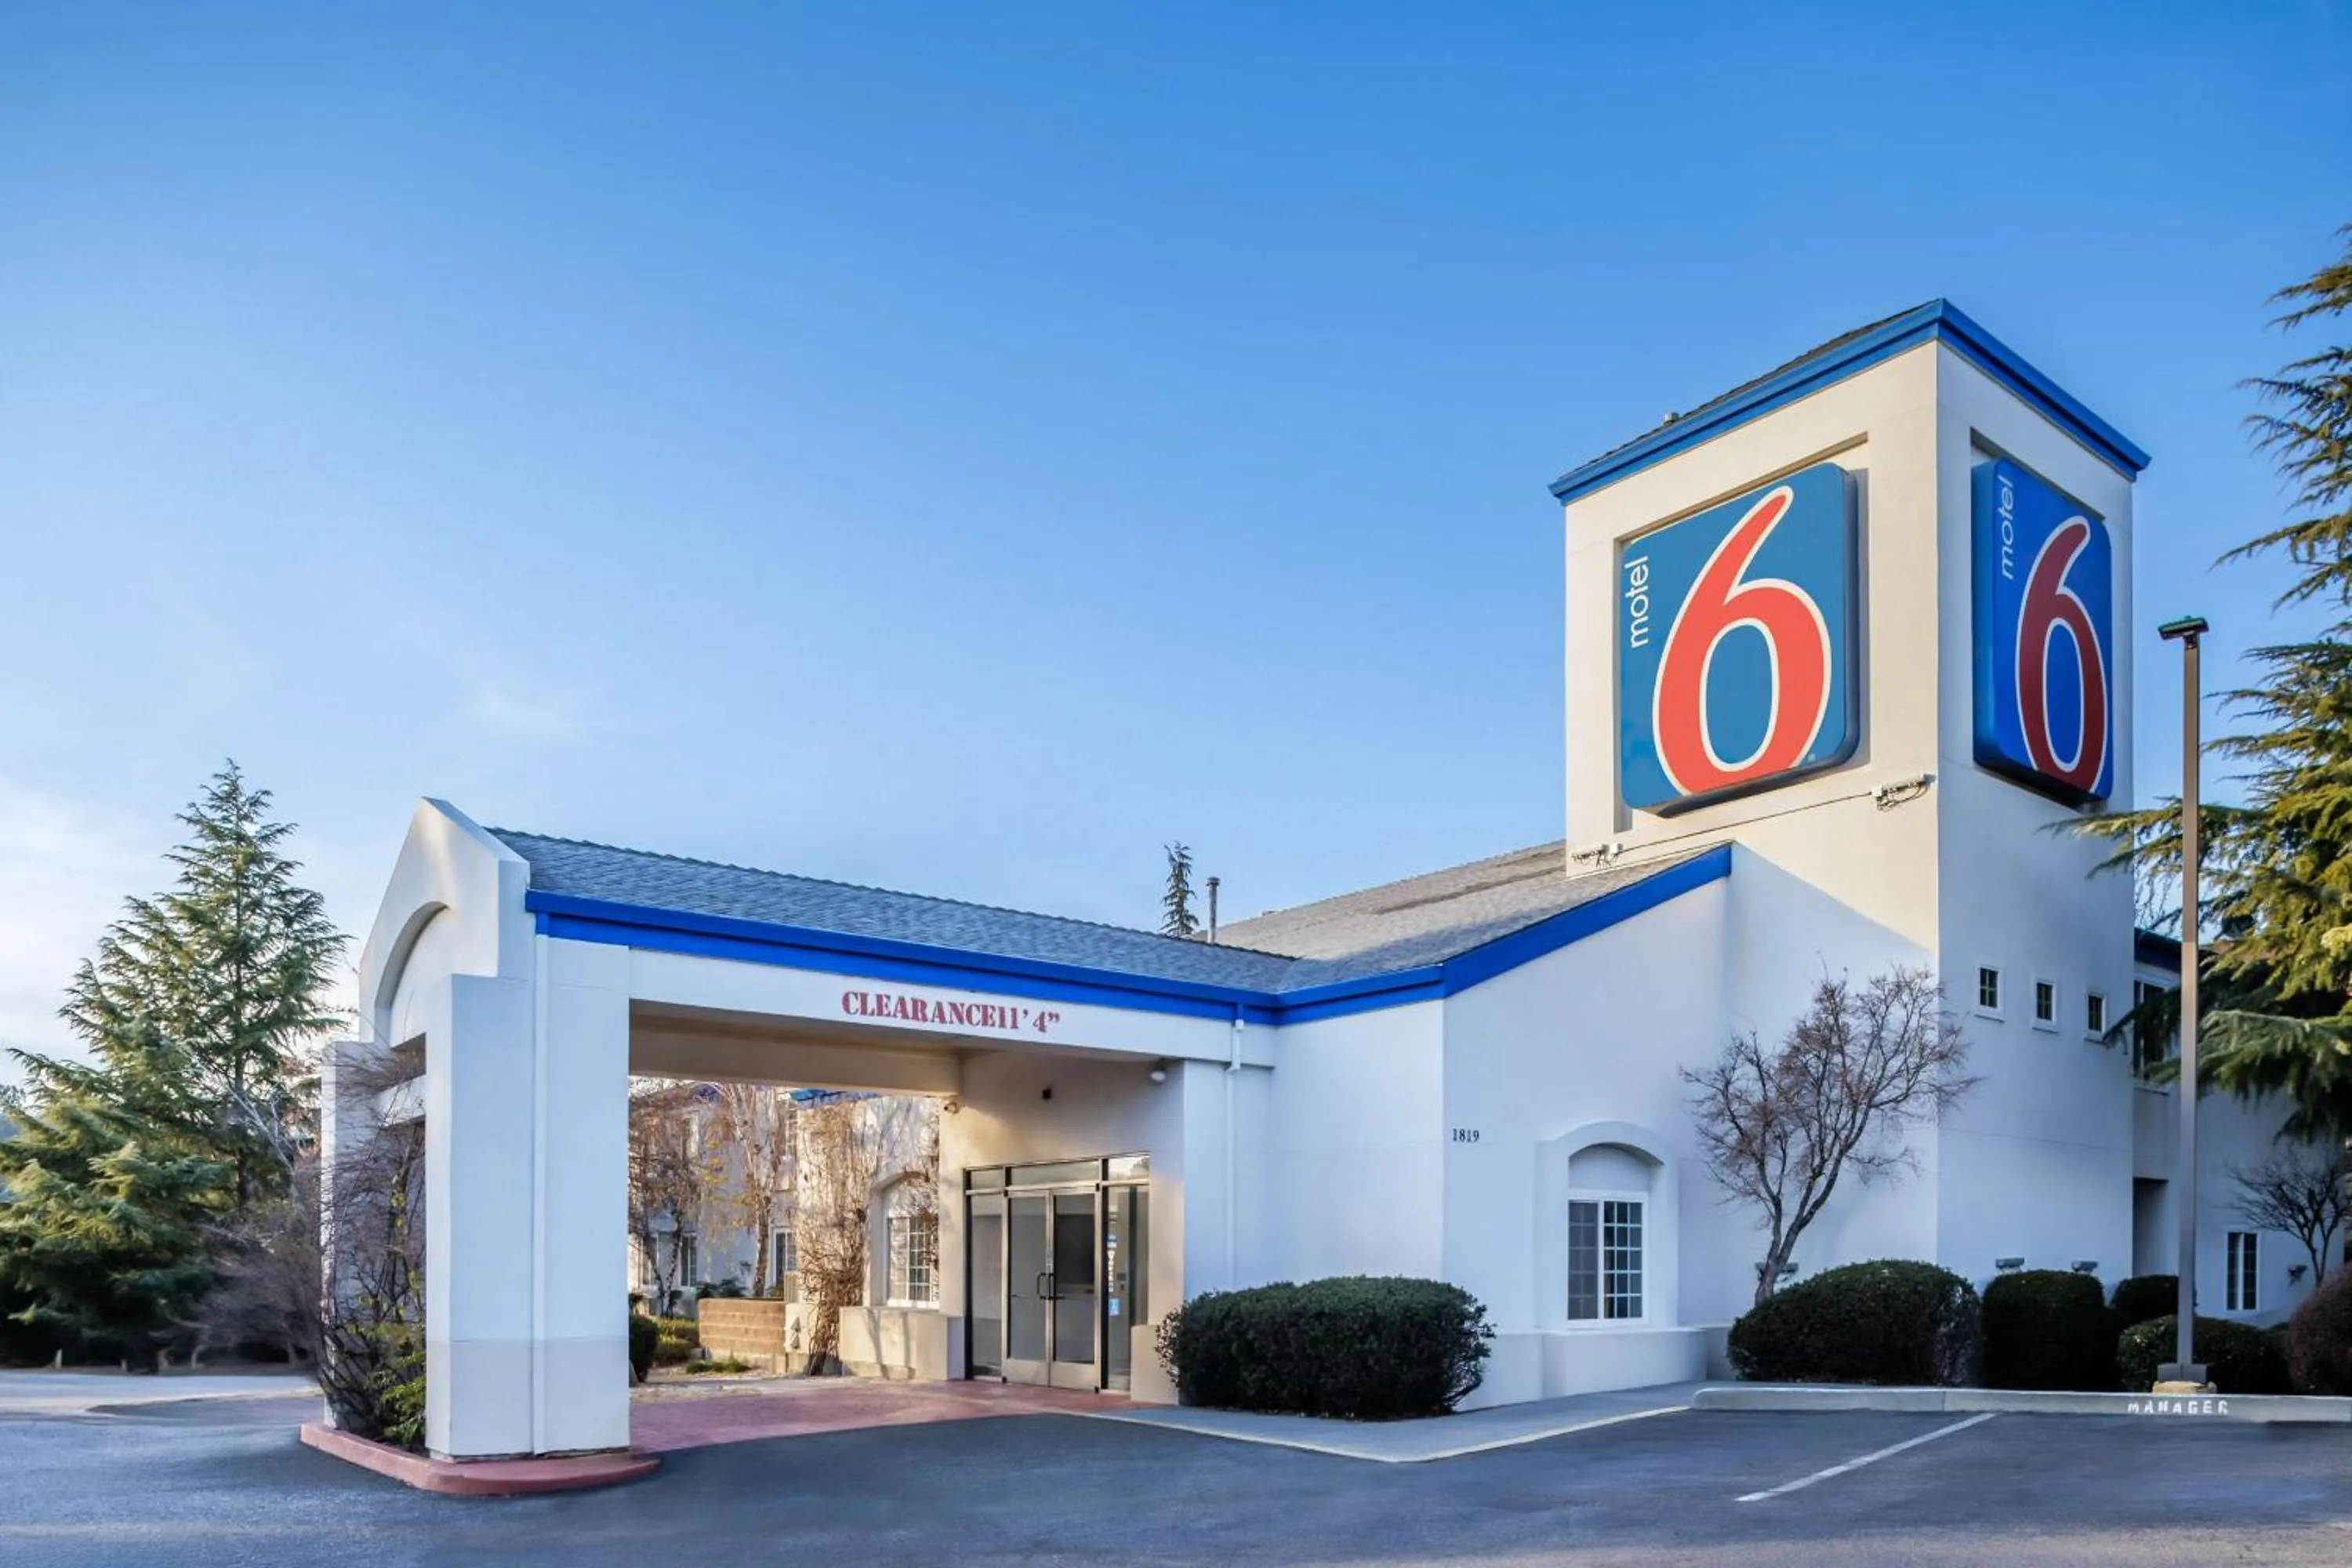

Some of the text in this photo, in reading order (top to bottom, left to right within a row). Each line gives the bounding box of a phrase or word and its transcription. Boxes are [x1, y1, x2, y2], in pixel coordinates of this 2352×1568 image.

[1625, 485, 1832, 796] motel 6
[1998, 474, 2107, 793] motel 6
[1453, 1129, 1479, 1142] 1819
[2127, 1399, 2229, 1414] MANAGER
